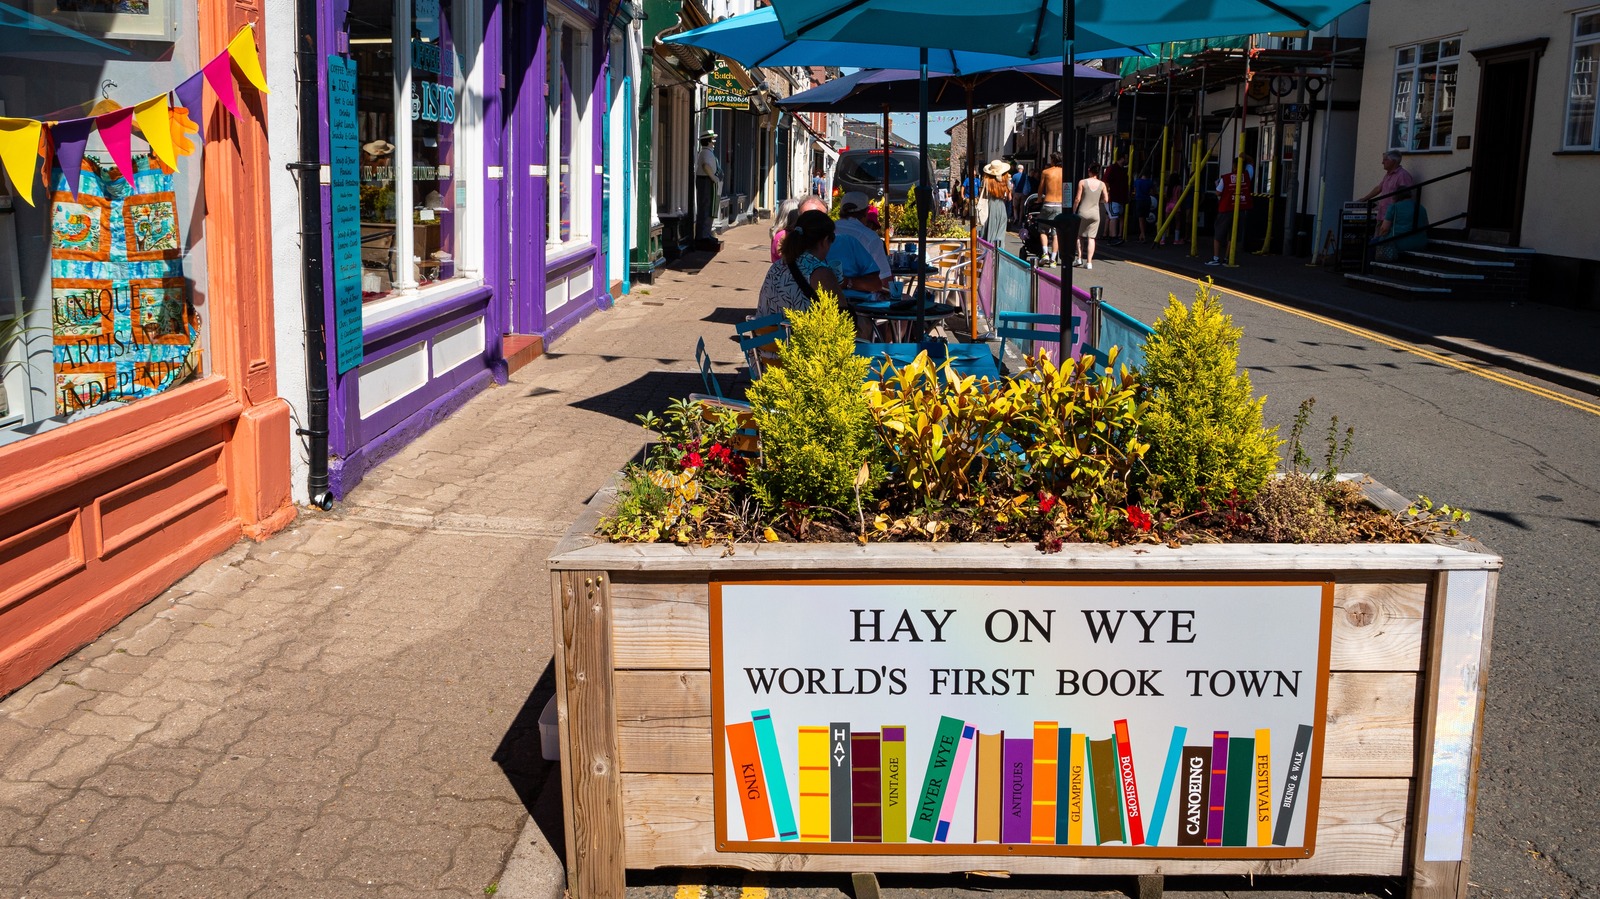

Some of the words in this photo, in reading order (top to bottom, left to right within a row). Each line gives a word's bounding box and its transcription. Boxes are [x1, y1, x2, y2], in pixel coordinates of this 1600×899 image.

[331, 65, 344, 75] COFFEE
[411, 39, 441, 74] OFFEE
[339, 80, 349, 92] ISIS
[421, 81, 455, 124] ISIS
[52, 284, 142, 326] UNIQUE
[60, 323, 155, 373] ARTISAN
[62, 348, 204, 418] INDEPENDENT
[849, 609, 957, 643] HAY
[984, 609, 1056, 643] ON
[1081, 610, 1197, 643] WYE
[743, 665, 907, 695] WORLD'S
[929, 668, 1035, 696] FIRST
[1055, 669, 1164, 697] BOOK
[1186, 670, 1302, 697] TOWN
[834, 729, 846, 767] HAY
[741, 763, 760, 800] KING
[889, 757, 898, 807] VINTAGE
[920, 778, 943, 822] RIVER
[934, 735, 954, 769] WYE
[1012, 762, 1024, 818] ANTIQUES
[1071, 765, 1082, 822] GLAMPING
[1121, 756, 1138, 817] BOOKSHOPS
[1186, 756, 1204, 835] CANOEING
[1257, 755, 1269, 822] FESTIVALS
[1283, 783, 1296, 808] BIKING
[1292, 751, 1304, 772] WALK
